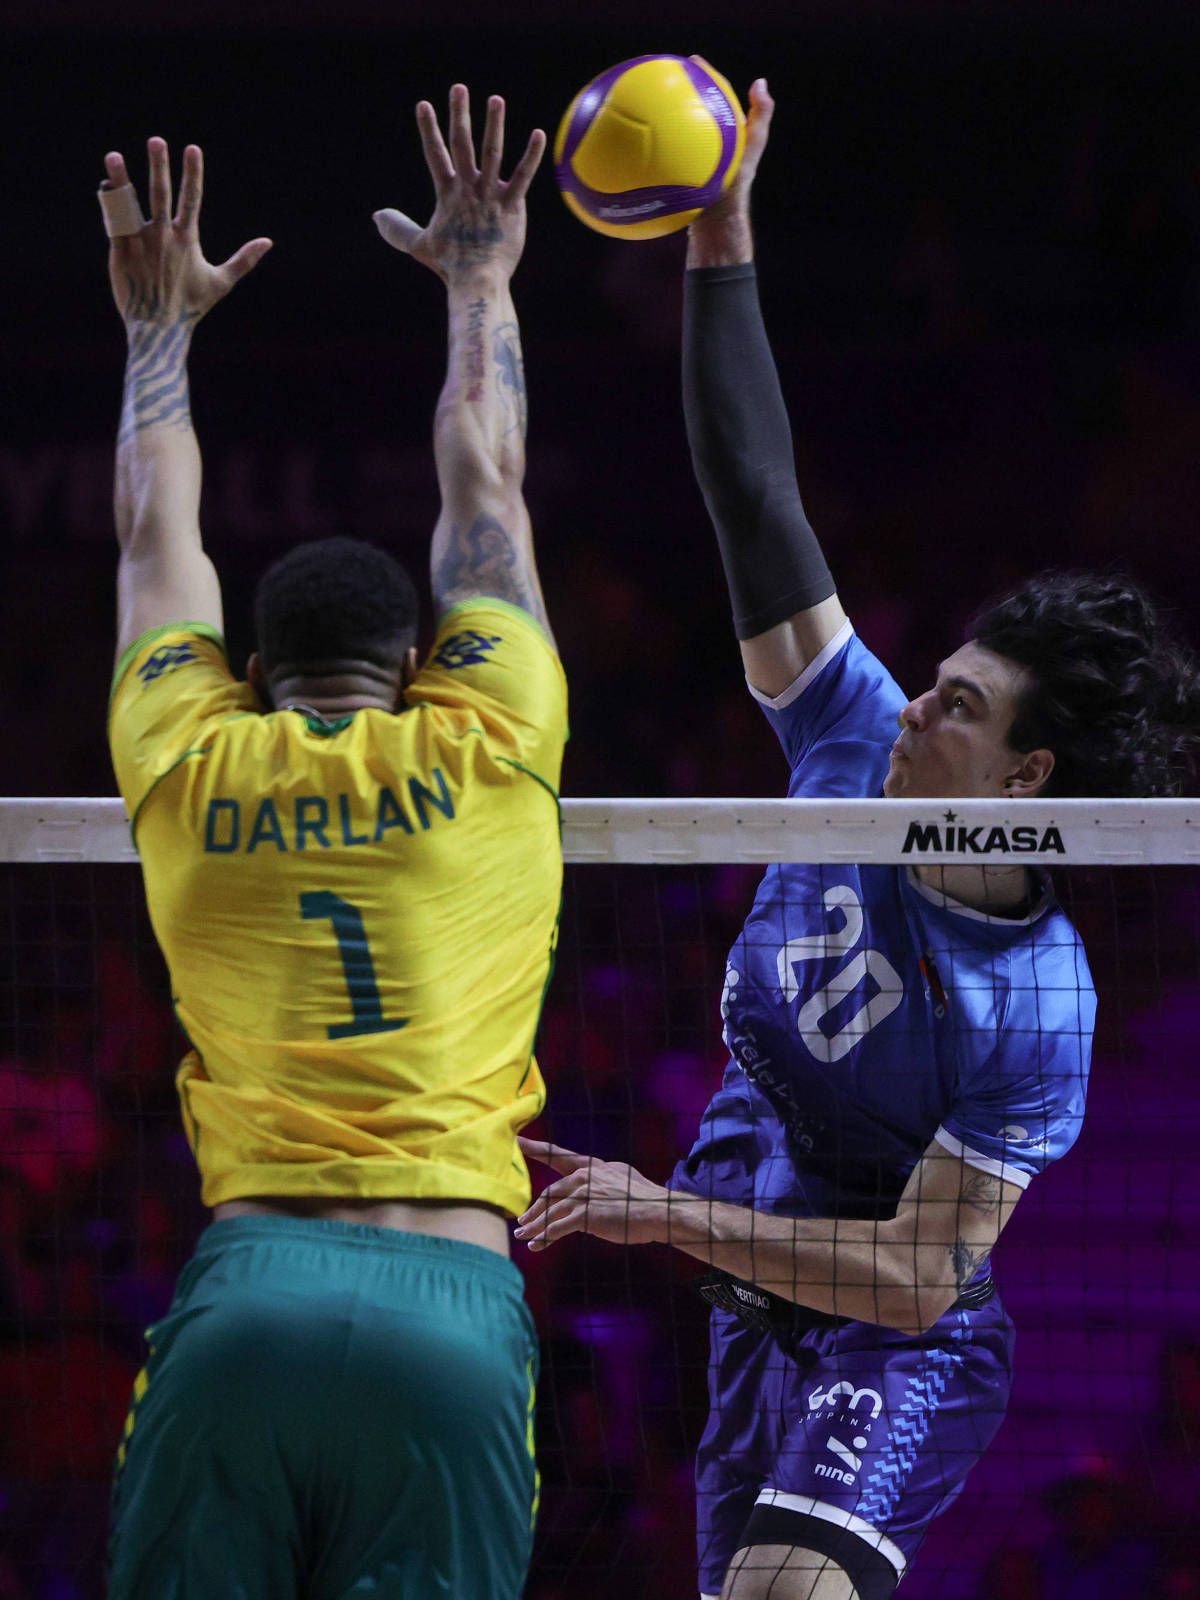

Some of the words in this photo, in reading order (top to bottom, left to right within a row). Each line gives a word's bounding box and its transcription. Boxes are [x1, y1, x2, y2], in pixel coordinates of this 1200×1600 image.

[205, 768, 455, 853] DARLAN
[901, 821, 1066, 853] MIKASA
[299, 890, 410, 1040] 1
[777, 886, 903, 1063] 20
[814, 1463, 856, 1486] nine
